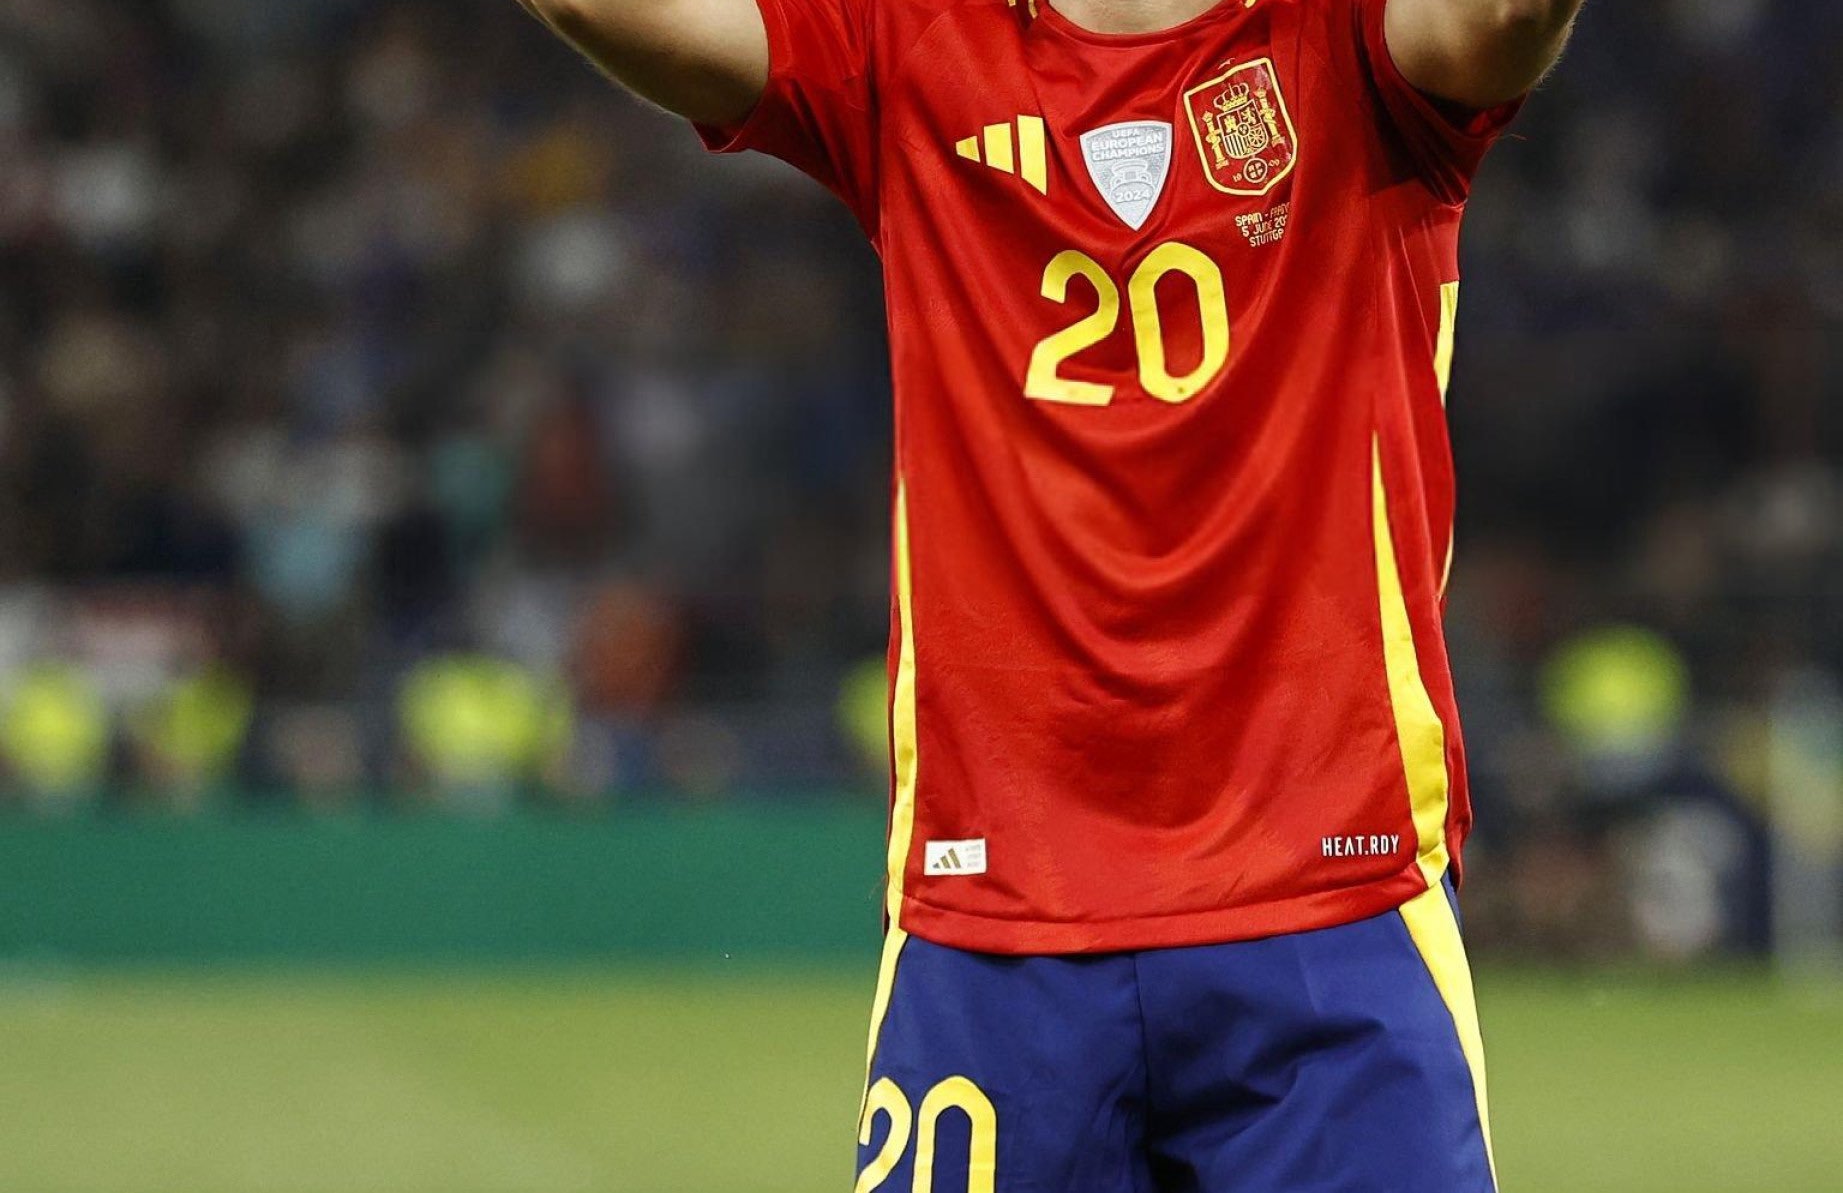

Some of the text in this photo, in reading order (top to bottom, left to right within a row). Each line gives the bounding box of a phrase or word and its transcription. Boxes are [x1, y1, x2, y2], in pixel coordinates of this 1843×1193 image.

[1091, 131, 1163, 151] EUROPEAN
[1112, 128, 1140, 138] UEFA
[1092, 142, 1165, 161] CHAMPIONS
[1115, 189, 1150, 203] 2024
[1235, 212, 1262, 227] SPAIN
[1241, 225, 1250, 237] 5
[1273, 214, 1288, 228] 20
[1024, 241, 1229, 405] 20
[1321, 834, 1400, 857] HEAT.RDY
[853, 1075, 997, 1193] 20
